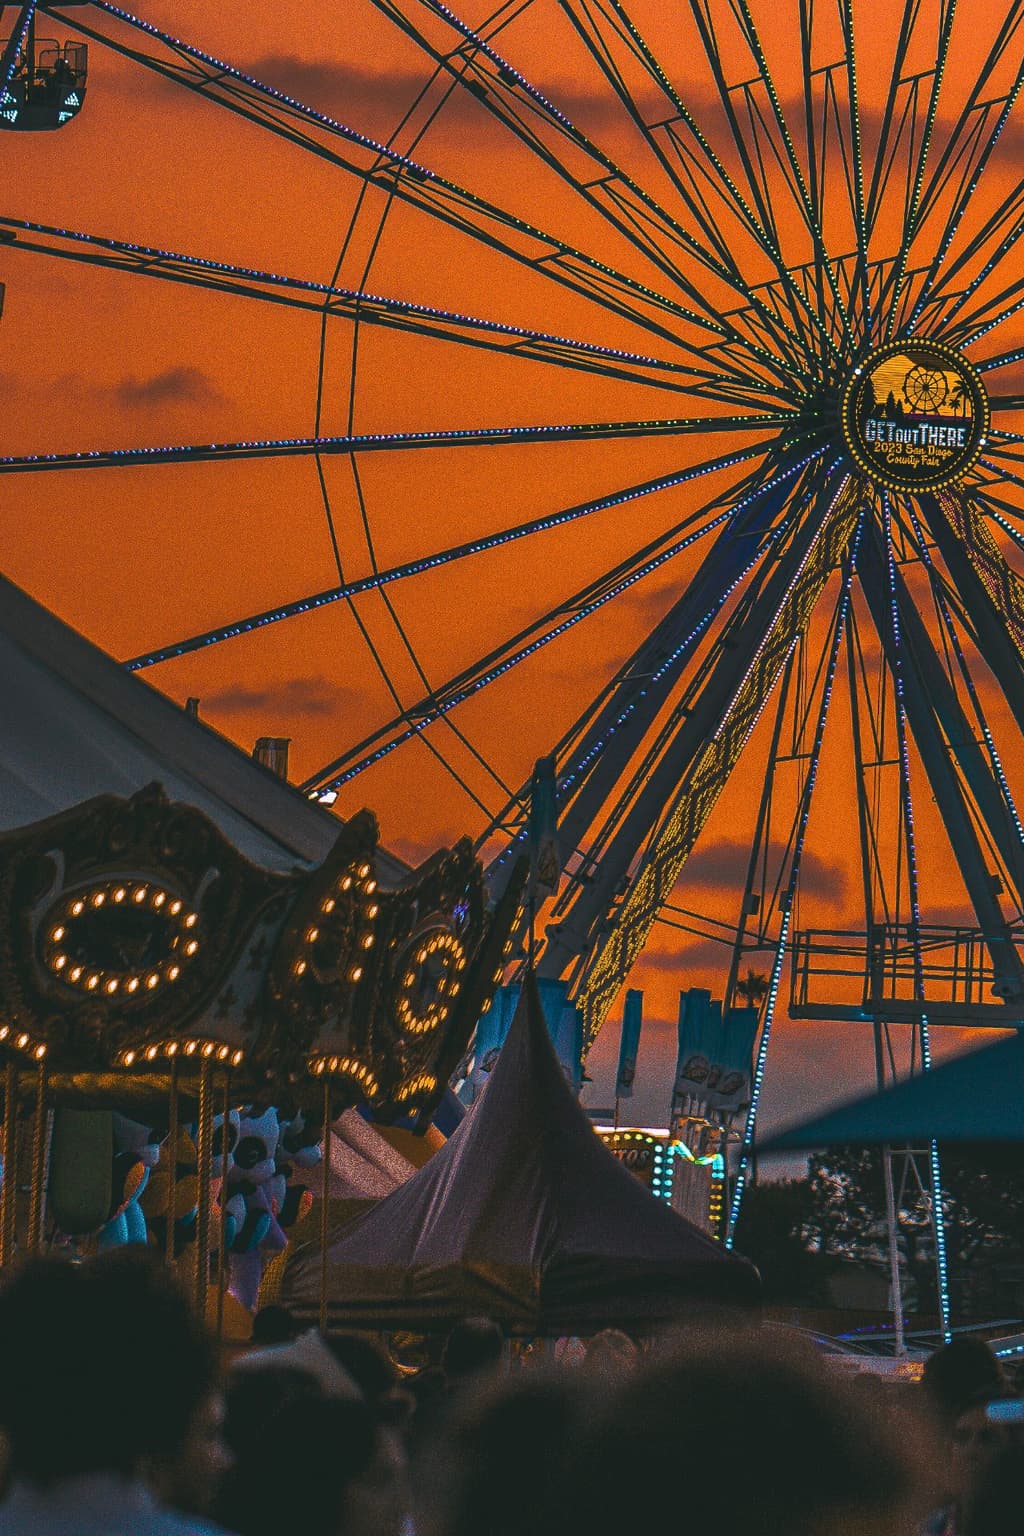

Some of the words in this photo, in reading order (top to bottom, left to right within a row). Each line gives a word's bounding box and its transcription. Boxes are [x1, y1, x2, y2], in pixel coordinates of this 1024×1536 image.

[874, 442, 902, 453] 2023
[906, 444, 926, 454] San
[927, 445, 954, 460] Diego
[886, 453, 920, 468] County
[921, 455, 940, 466] Fair
